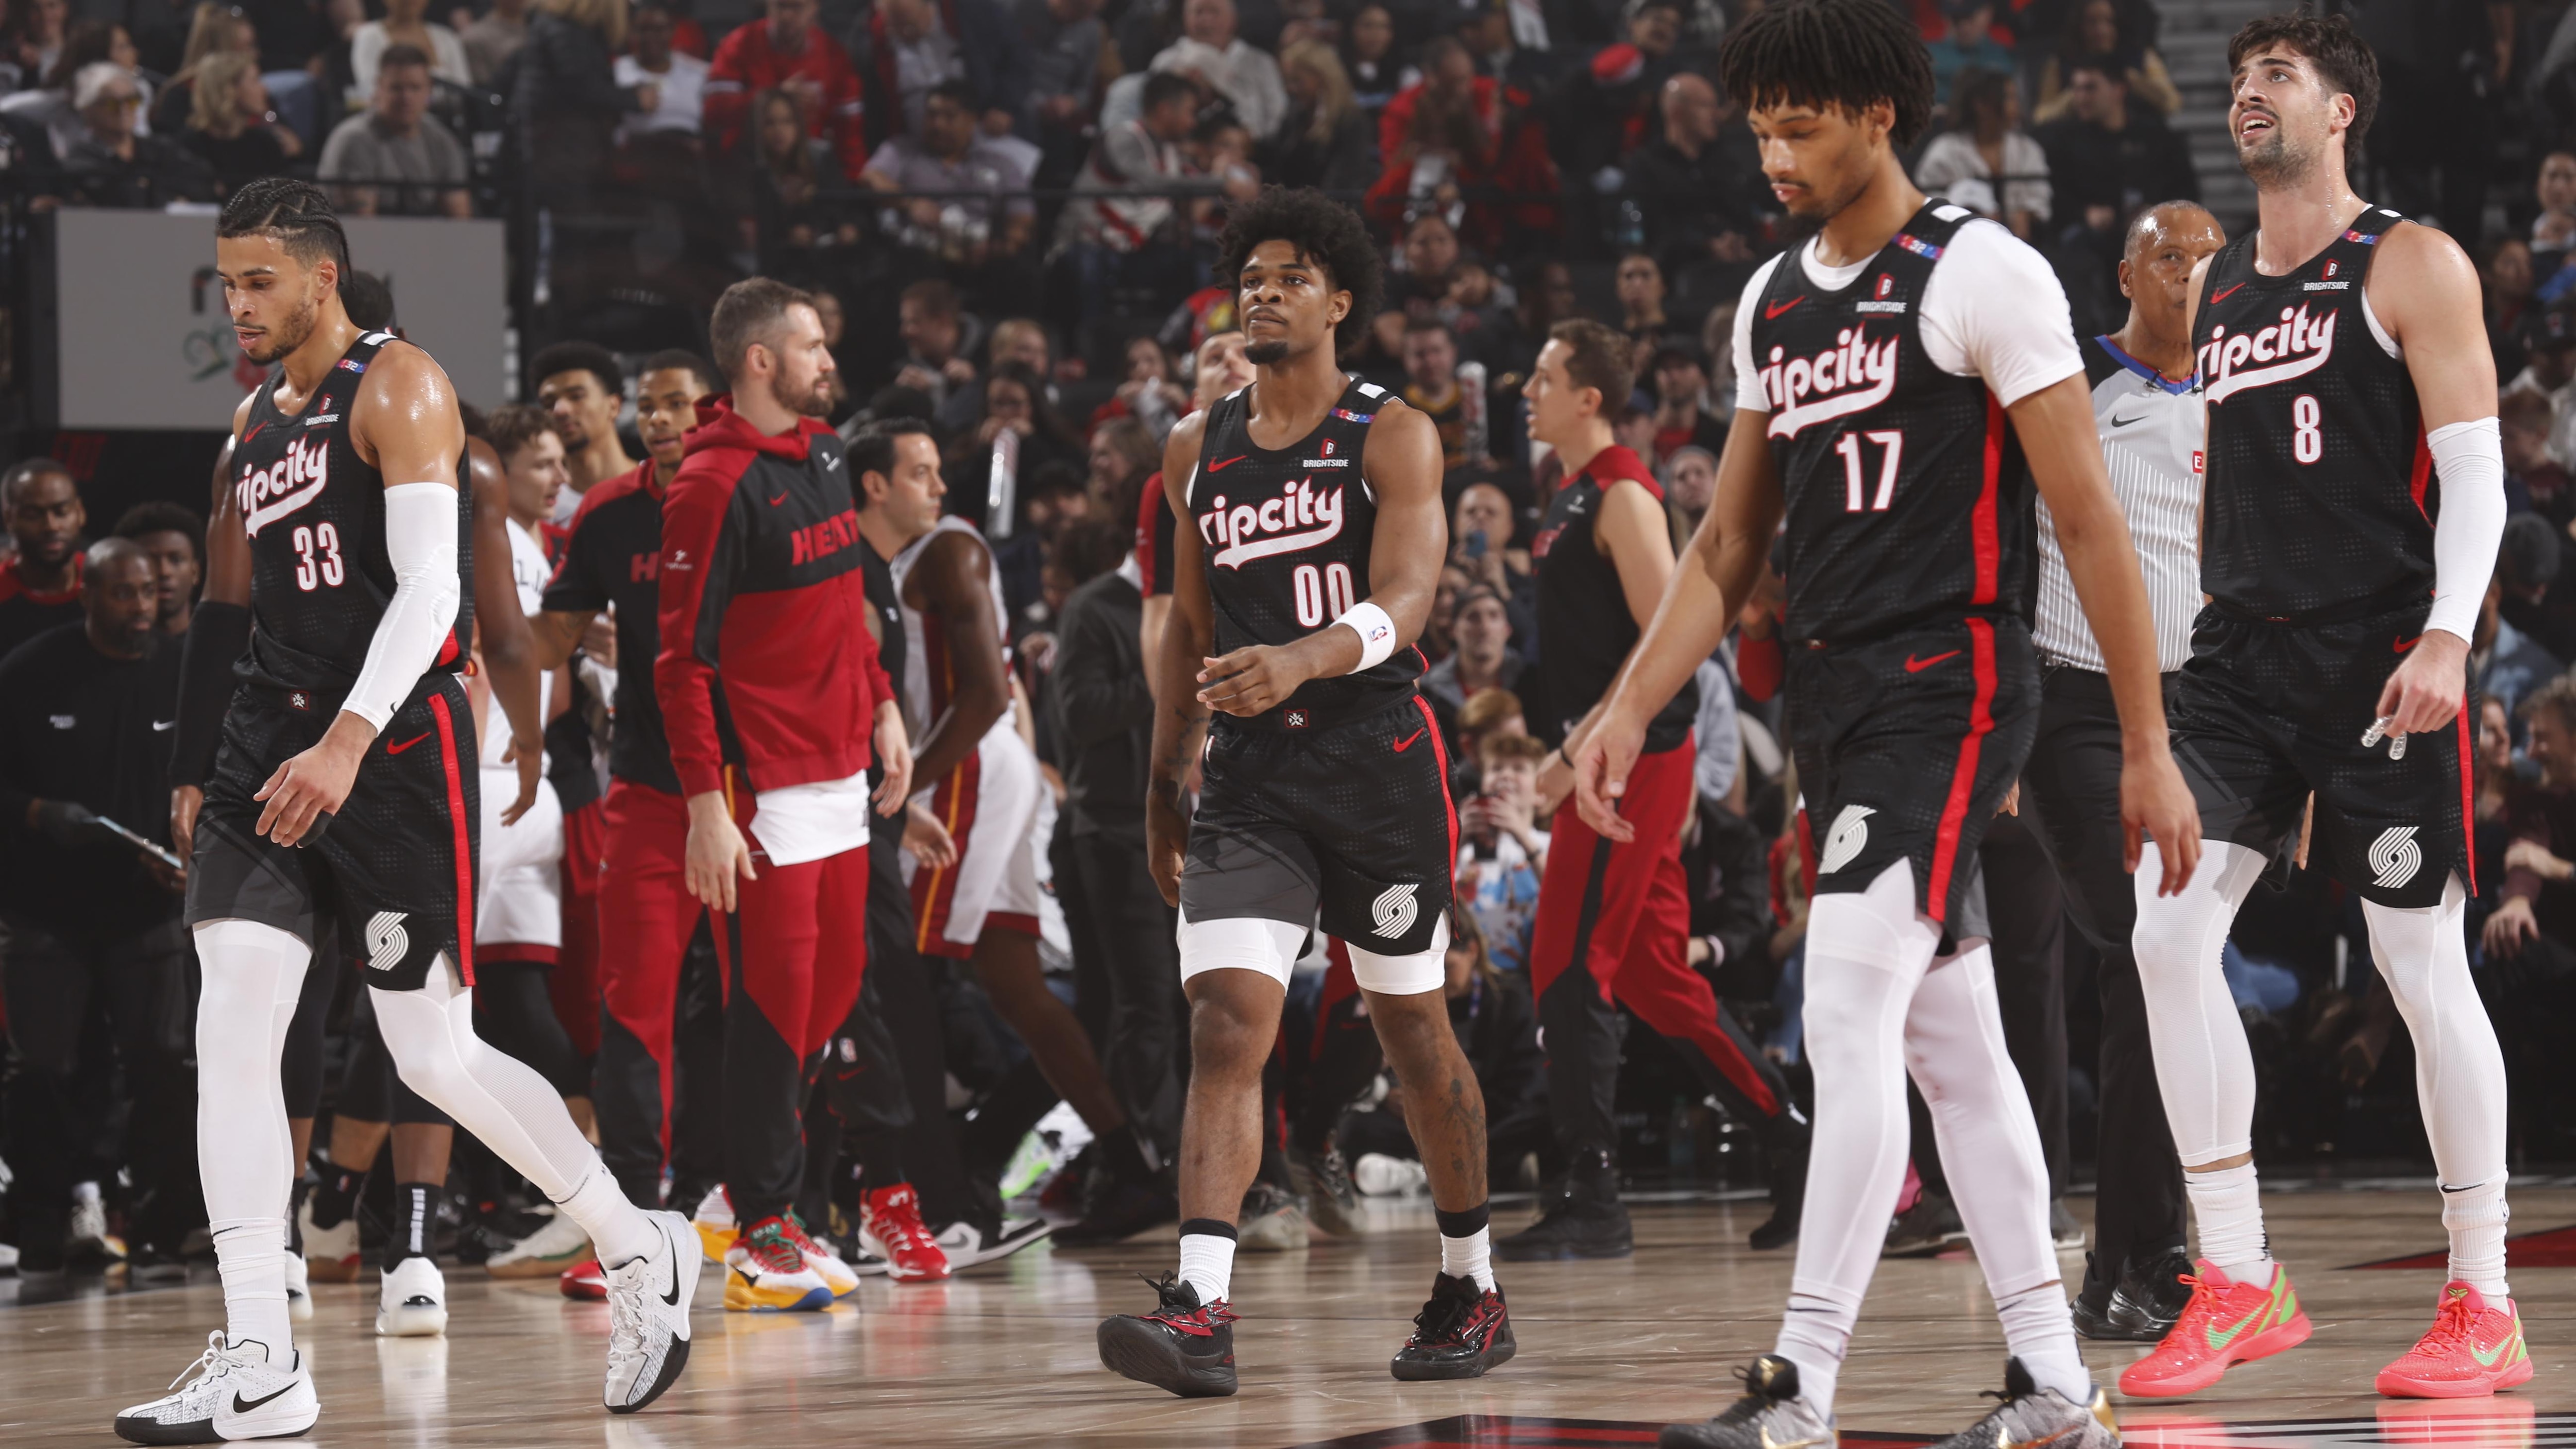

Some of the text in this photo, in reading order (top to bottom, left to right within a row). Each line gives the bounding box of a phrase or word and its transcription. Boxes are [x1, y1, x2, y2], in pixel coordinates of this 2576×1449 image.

[1856, 301, 1907, 313] BRIGHTSIDE
[2303, 281, 2350, 291] BRIGHTSIDE
[345, 361, 359, 371] 32
[1758, 320, 1900, 440] ripcity
[2197, 300, 2338, 406] ripcity
[306, 414, 340, 426] BRIGHTSIDE
[1346, 412, 1360, 422] 32
[2293, 394, 2323, 466] 8
[1302, 459, 1349, 468] BRIGHTSIDE
[1835, 428, 1903, 513] 17
[790, 508, 860, 566] HEAT
[1198, 475, 1344, 571] ripcity
[293, 520, 345, 592] 33
[1292, 561, 1357, 628] 00
